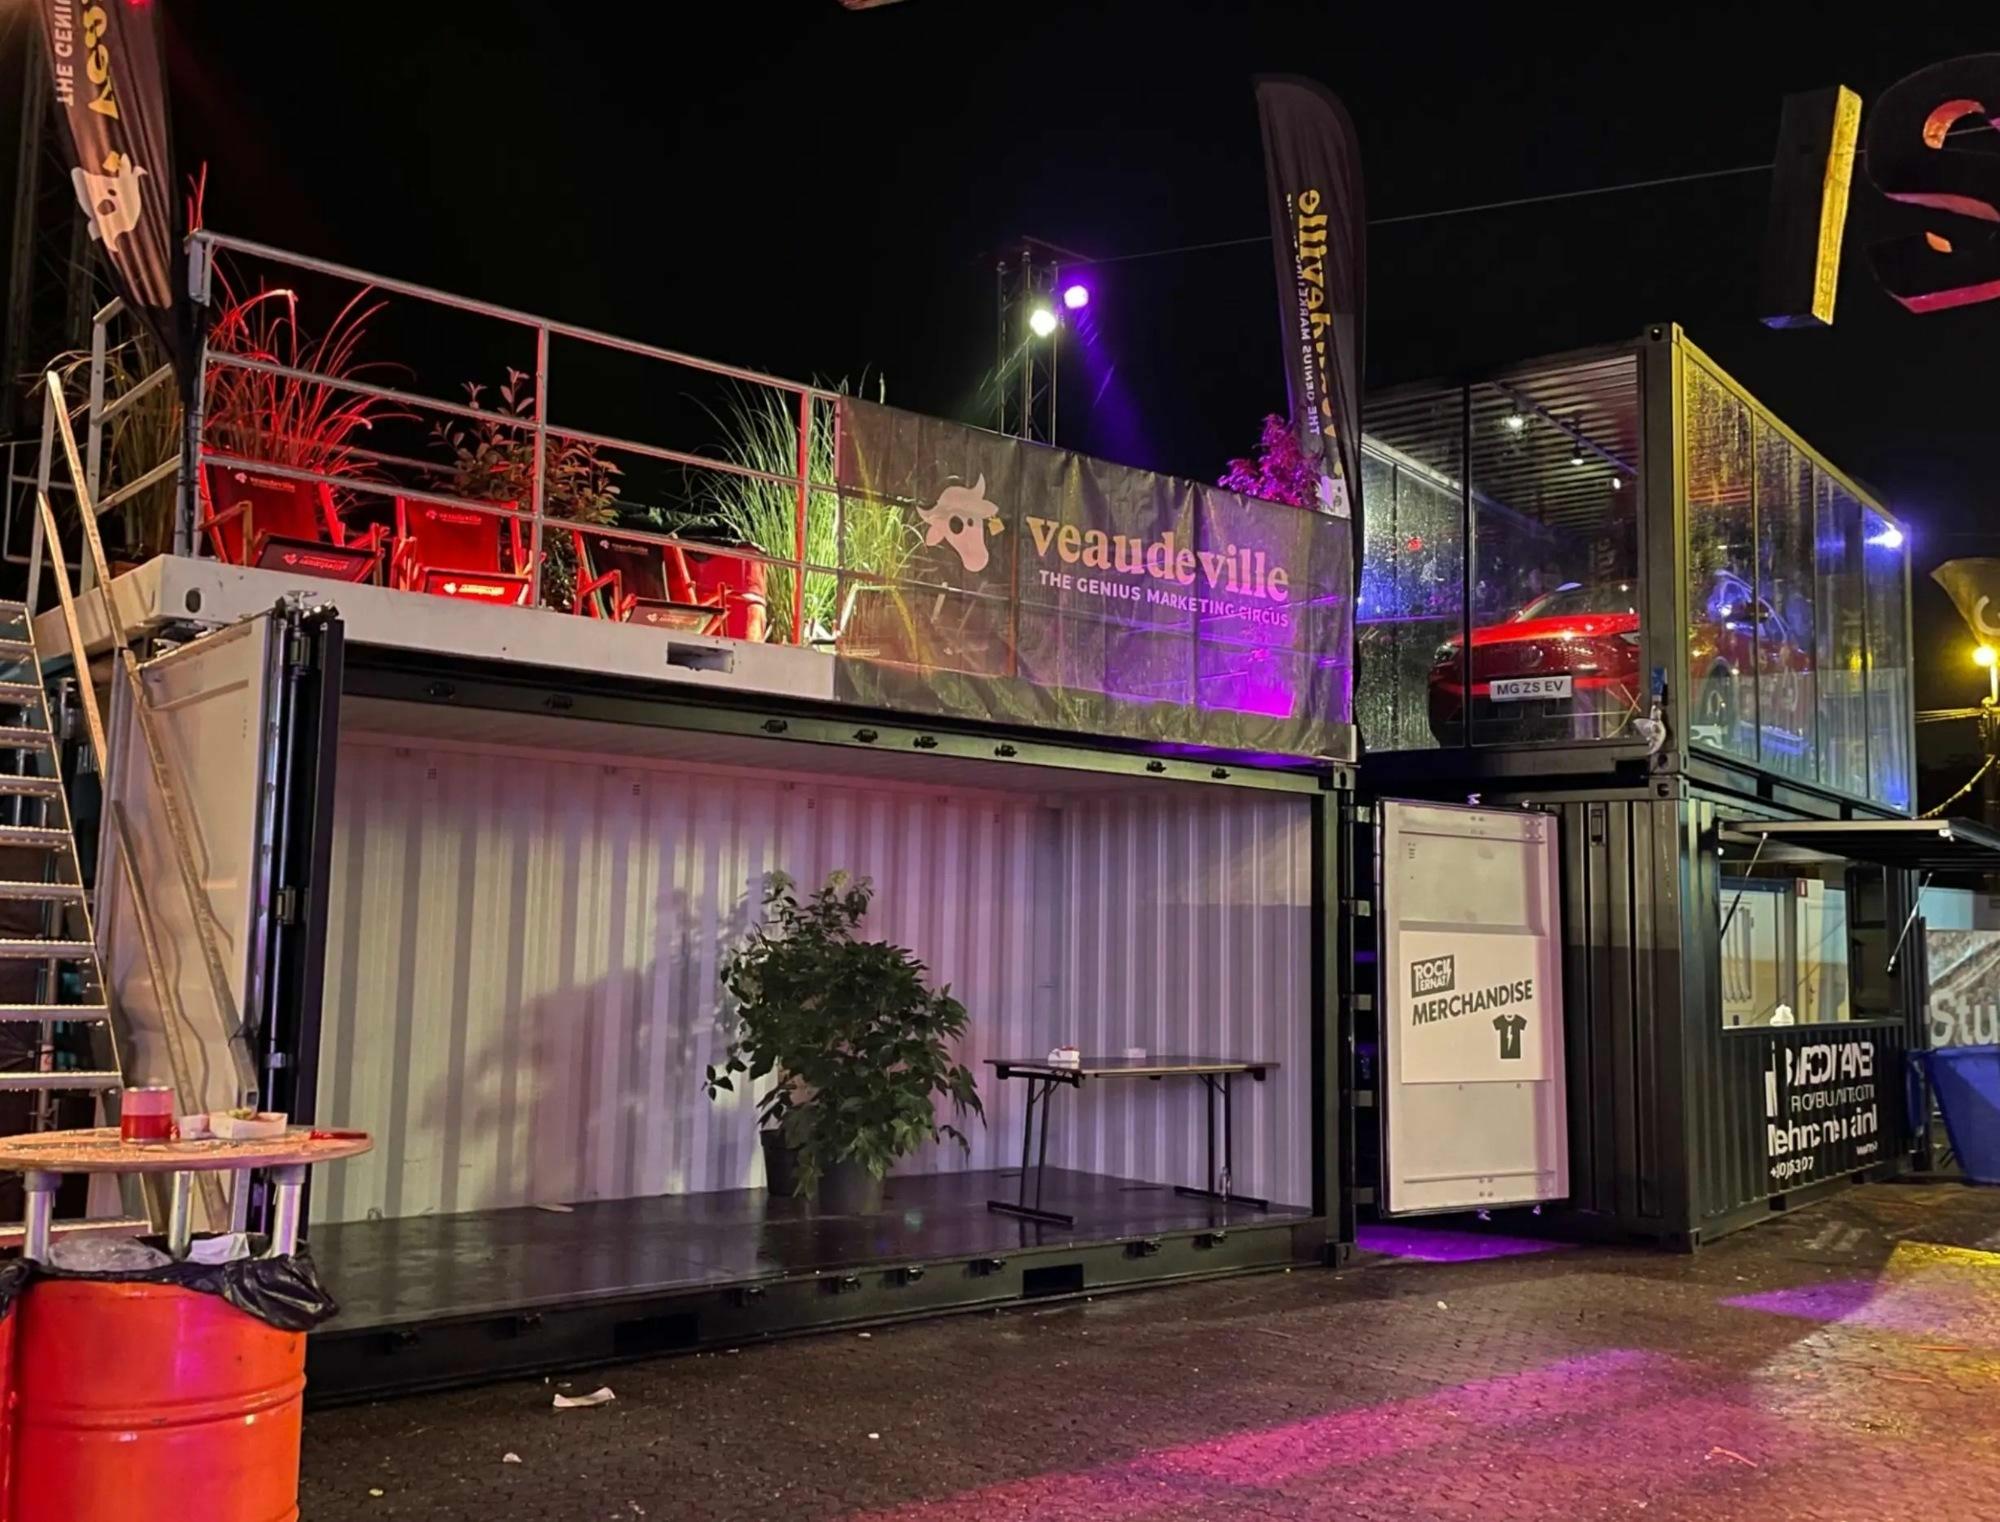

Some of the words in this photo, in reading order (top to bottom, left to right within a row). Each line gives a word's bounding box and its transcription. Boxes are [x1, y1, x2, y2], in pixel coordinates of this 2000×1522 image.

[1026, 516, 1290, 602] veaudeville
[1039, 569, 1071, 590] THE
[1077, 577, 1141, 600] GENIUS
[1146, 588, 1235, 616] MARKETING
[1238, 605, 1290, 628] CIRCUS
[1496, 683, 1520, 695] MG
[1523, 682, 1541, 693] ZS
[1545, 680, 1563, 691] EV
[1412, 979, 1533, 1026] MERCHANDISE
